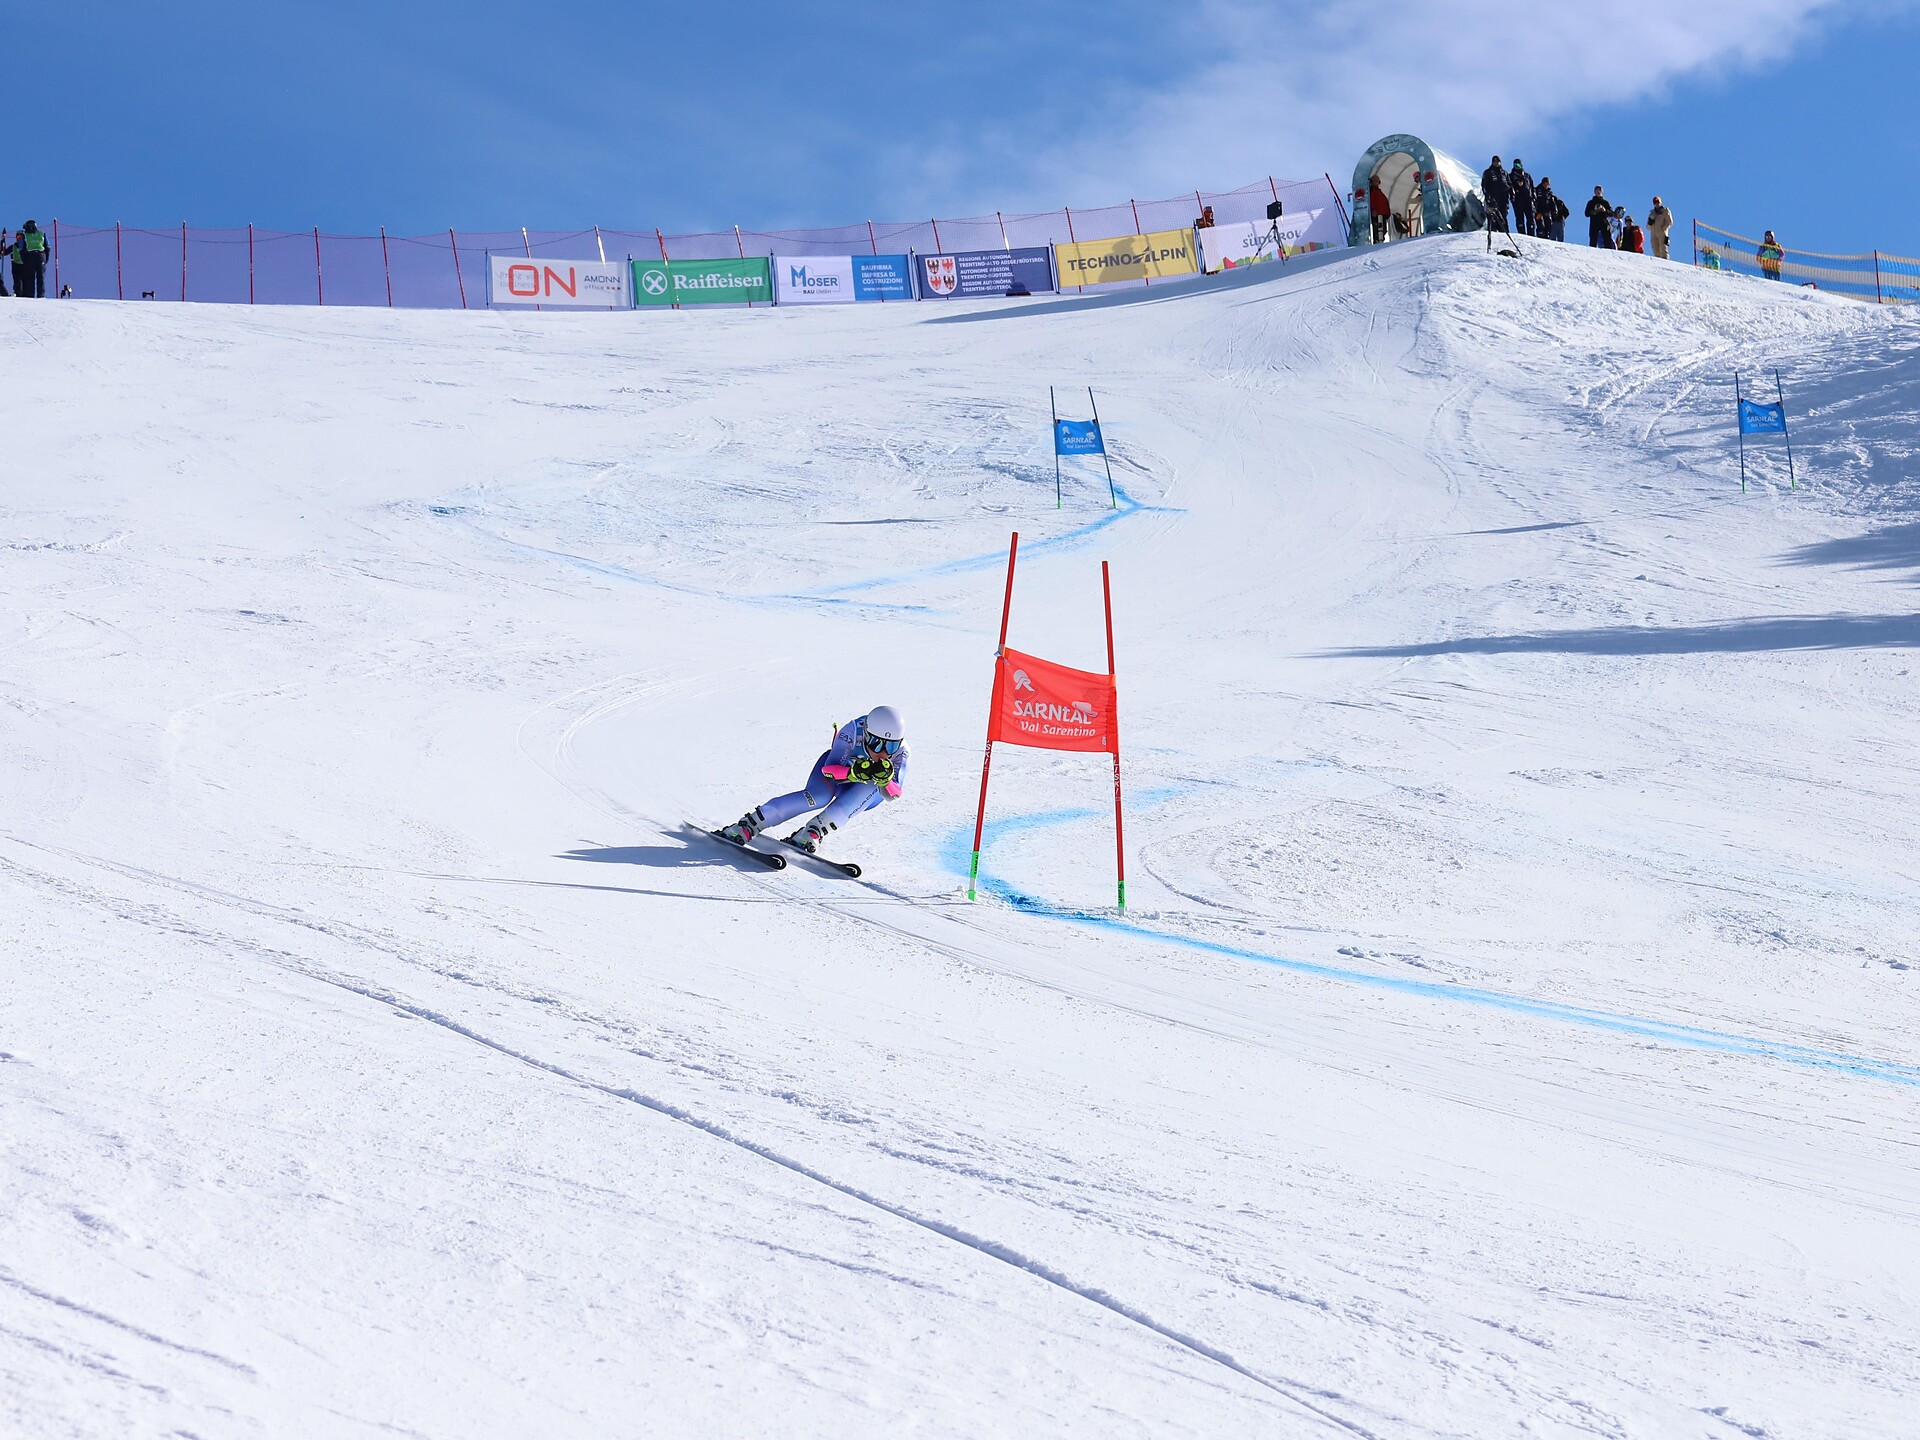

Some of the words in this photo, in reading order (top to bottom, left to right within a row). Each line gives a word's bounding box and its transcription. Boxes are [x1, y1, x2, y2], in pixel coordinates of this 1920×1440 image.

[1067, 246, 1187, 271] TECHNOALPIN
[508, 265, 576, 297] ON
[584, 275, 621, 283] AMONN
[673, 273, 764, 289] Raiffeisen
[790, 265, 838, 287] MOSER
[1020, 721, 1039, 733] Val
[1042, 724, 1096, 737] Sarentino
